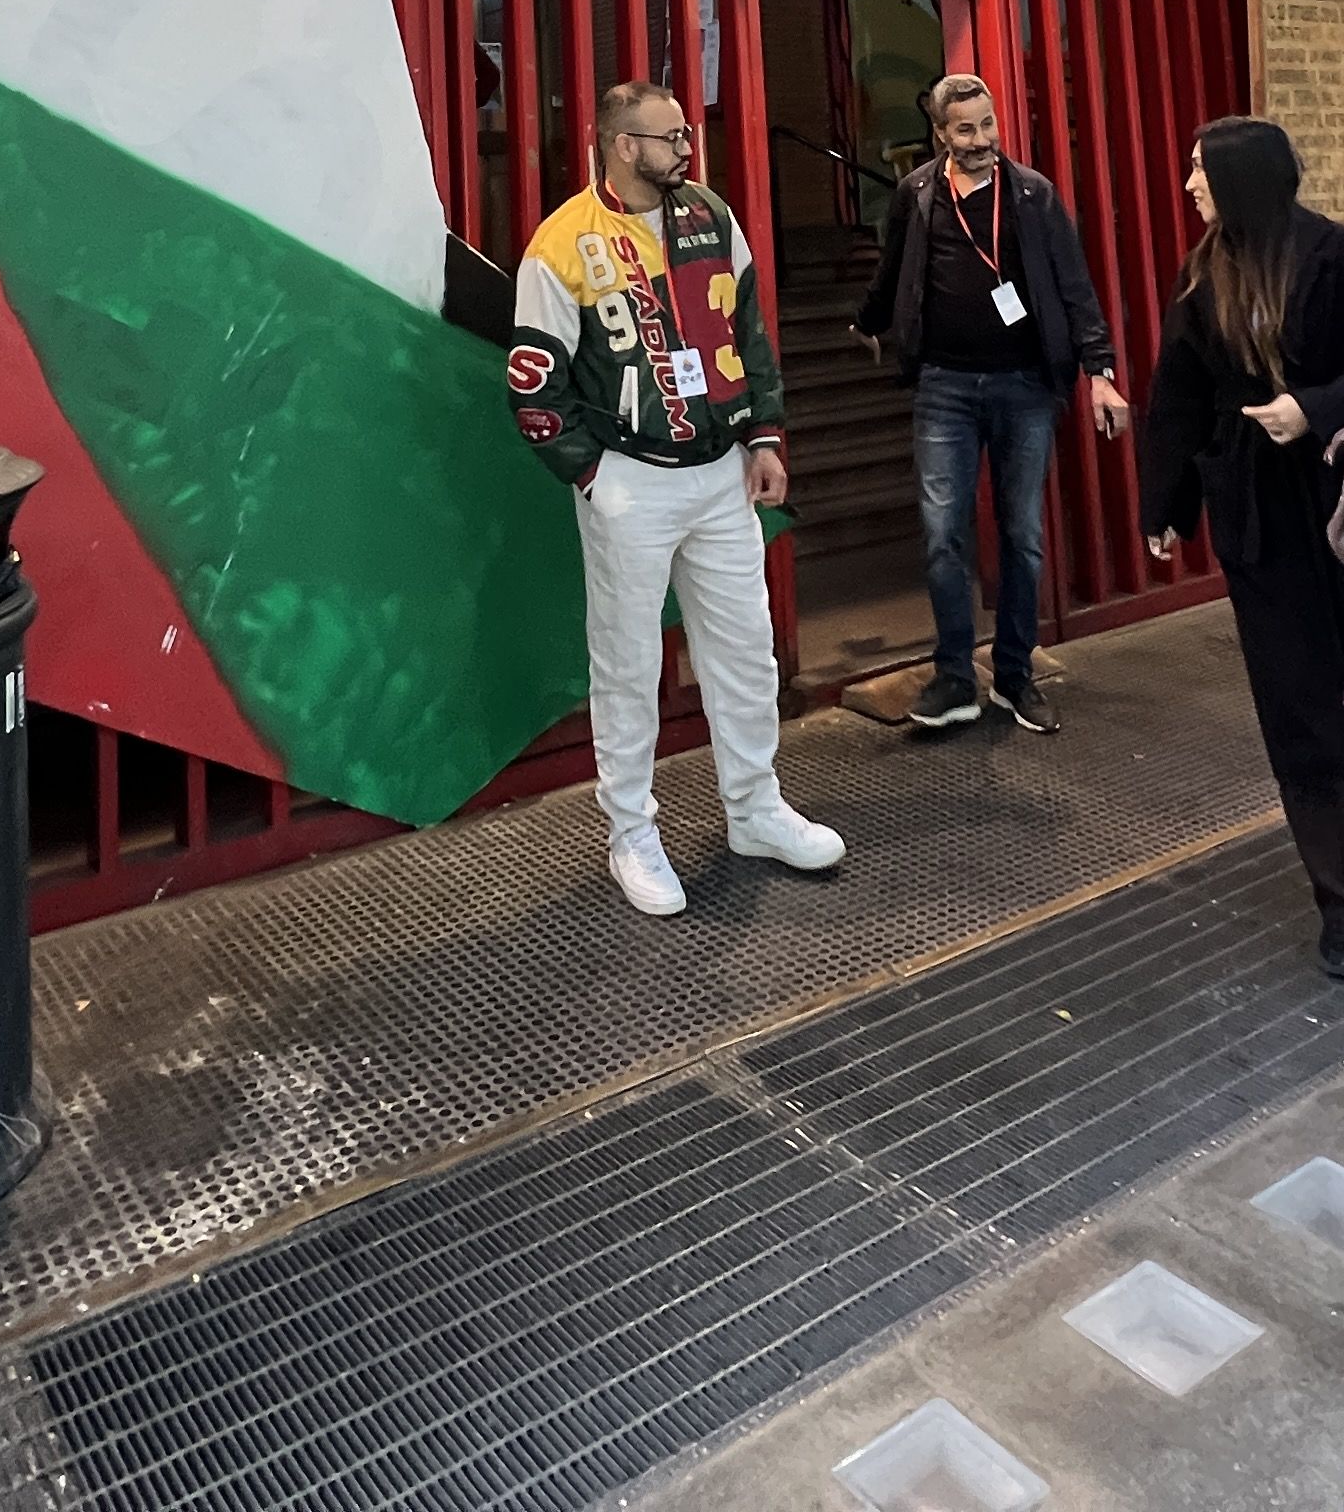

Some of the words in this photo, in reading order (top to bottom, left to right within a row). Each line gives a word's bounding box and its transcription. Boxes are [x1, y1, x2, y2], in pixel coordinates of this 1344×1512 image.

[575, 231, 617, 292] 8
[595, 291, 639, 353] 9
[609, 234, 697, 443] STADIUM
[506, 345, 556, 395] S
